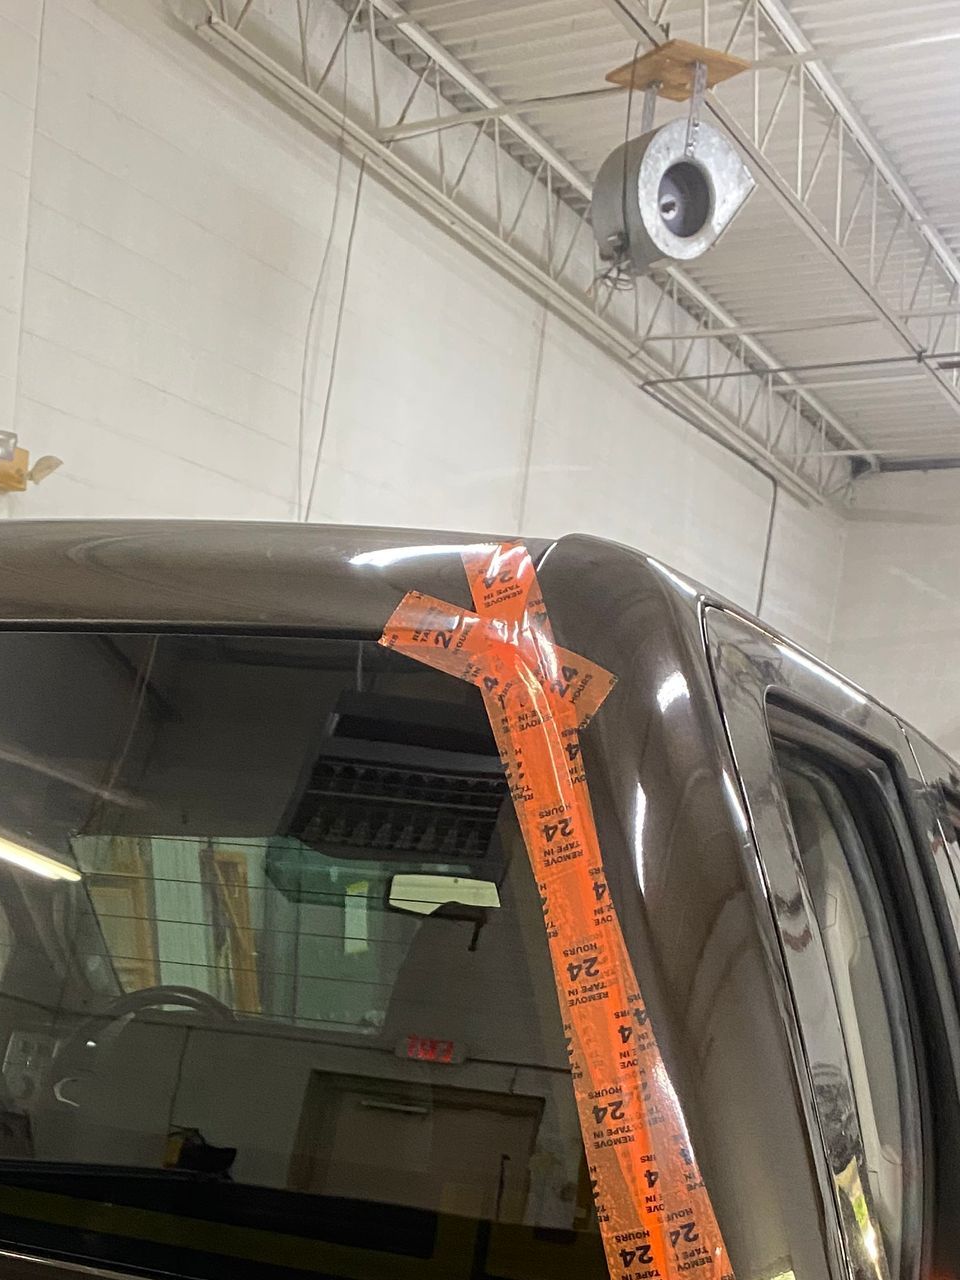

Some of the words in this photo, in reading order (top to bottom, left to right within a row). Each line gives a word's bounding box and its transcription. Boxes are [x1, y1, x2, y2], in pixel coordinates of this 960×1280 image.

[539, 804, 572, 818] HOURS
[542, 817, 574, 843] 24
[543, 849, 555, 857] IN
[556, 840, 581, 852] TAPE
[543, 849, 584, 867] REMOVE
[563, 942, 597, 957] HOURS
[566, 956, 600, 982] 24
[568, 989, 579, 997] IN
[581, 981, 607, 993] TAPE
[568, 991, 609, 1007] REMOVE
[588, 1085, 622, 1099] HOURS
[592, 1100, 625, 1124] 24
[593, 1130, 605, 1139] IN
[607, 1125, 633, 1136] TAPE
[593, 1135, 635, 1149] REMOVE
[615, 1230, 650, 1243] HOURS
[619, 1244, 654, 1268] 24
[683, 1245, 709, 1257] TAPE
[635, 1269, 661, 1280] TAPE
